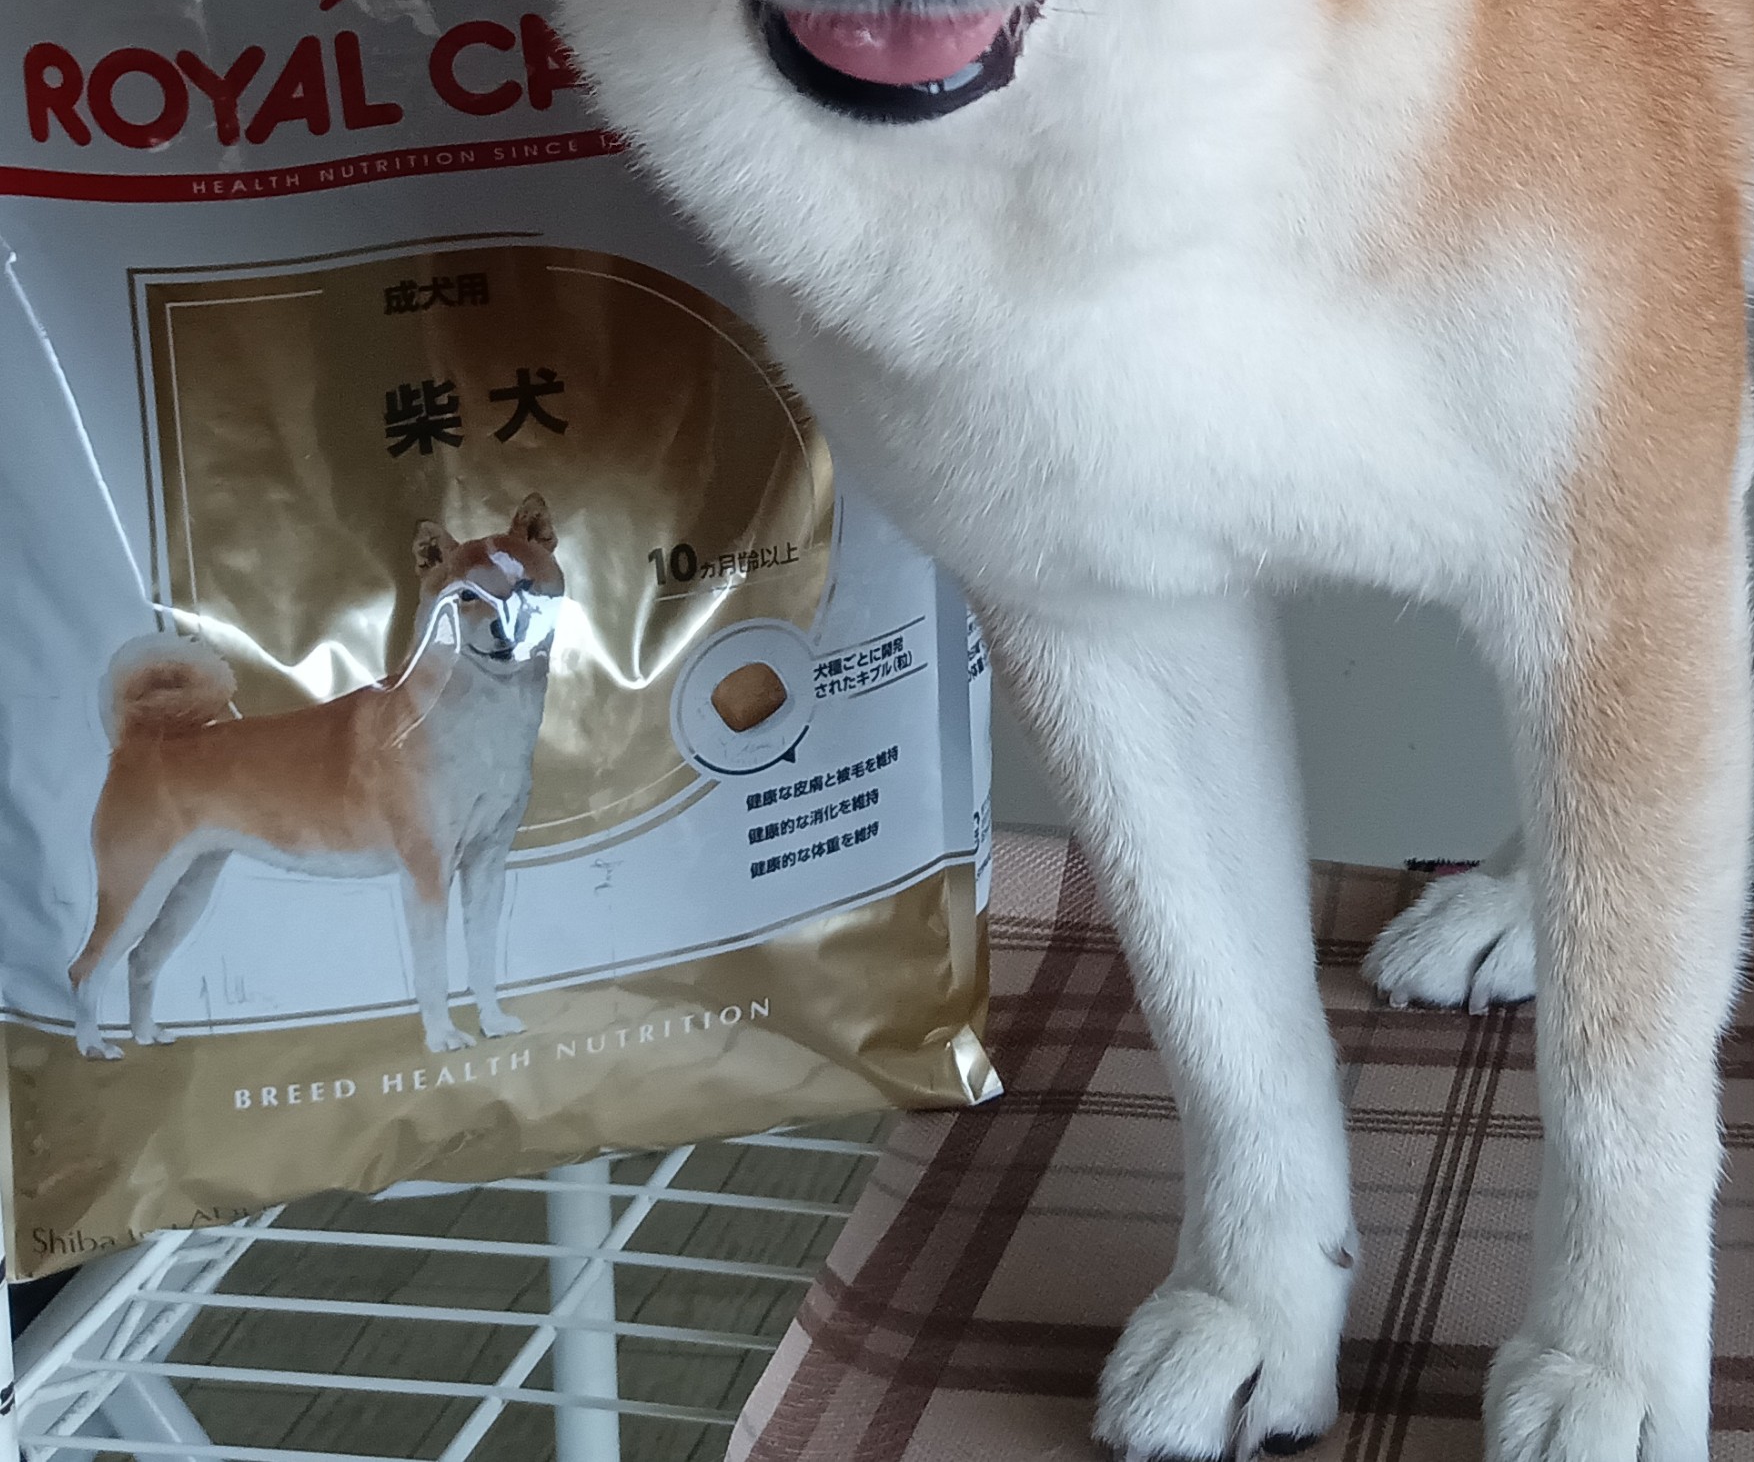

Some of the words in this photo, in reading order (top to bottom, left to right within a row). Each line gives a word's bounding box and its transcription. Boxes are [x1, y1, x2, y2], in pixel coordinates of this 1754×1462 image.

[23, 30, 404, 149] ROYAL
[429, 13, 597, 116] CA
[192, 172, 300, 196] HEALTH
[319, 149, 476, 184] NUTRITION
[494, 139, 578, 161] SINCE
[383, 272, 490, 316] 成犬用
[383, 367, 570, 459] 柴犬
[813, 635, 904, 682] 犬種ごとに開発
[746, 745, 899, 812] 健康な皮膚と被毛を維持
[748, 788, 880, 845] 健康的な消化を維持
[750, 821, 880, 879] 健康的な体重を維持
[233, 1079, 357, 1111] BREED
[381, 1049, 532, 1095] HEALTH
[555, 997, 770, 1060] NUTRITION
